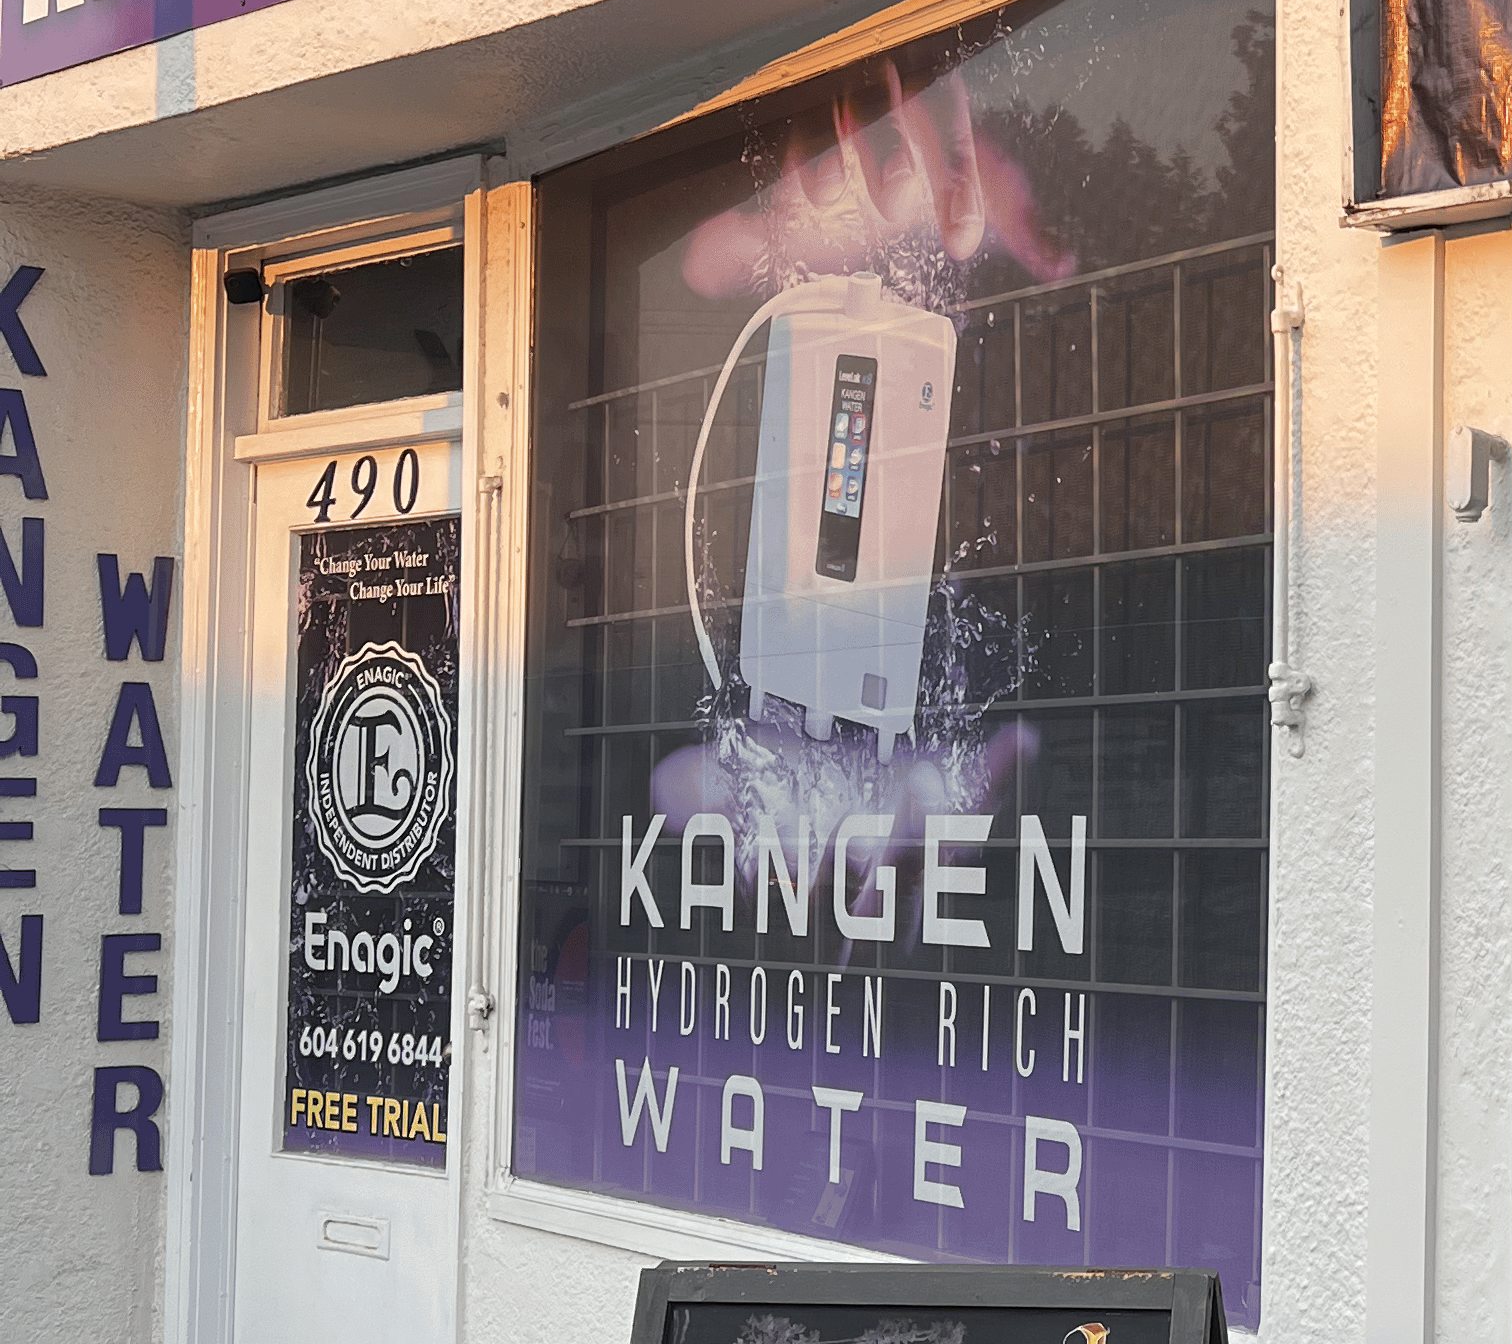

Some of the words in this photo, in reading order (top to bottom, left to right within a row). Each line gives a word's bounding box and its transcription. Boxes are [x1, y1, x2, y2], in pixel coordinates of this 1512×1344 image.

[305, 447, 420, 523] 490
[350, 581, 393, 603] Change
[395, 578, 424, 596] Your
[363, 553, 392, 571] Your
[393, 550, 429, 567] Water
[87, 552, 175, 1177] WATER
[320, 772, 379, 871] INDEPENDENT
[381, 771, 438, 870] DISTRIBUTOR
[619, 812, 1087, 955] KANGEN
[299, 1025, 338, 1059] 604
[343, 1029, 384, 1062] 619
[387, 1032, 443, 1068] 6844
[615, 956, 884, 1059] HYDROGEN
[937, 981, 1086, 1084] RICH
[290, 1088, 358, 1132] FREE
[366, 1096, 447, 1143] TRIAL
[615, 1056, 1084, 1232] WATER
